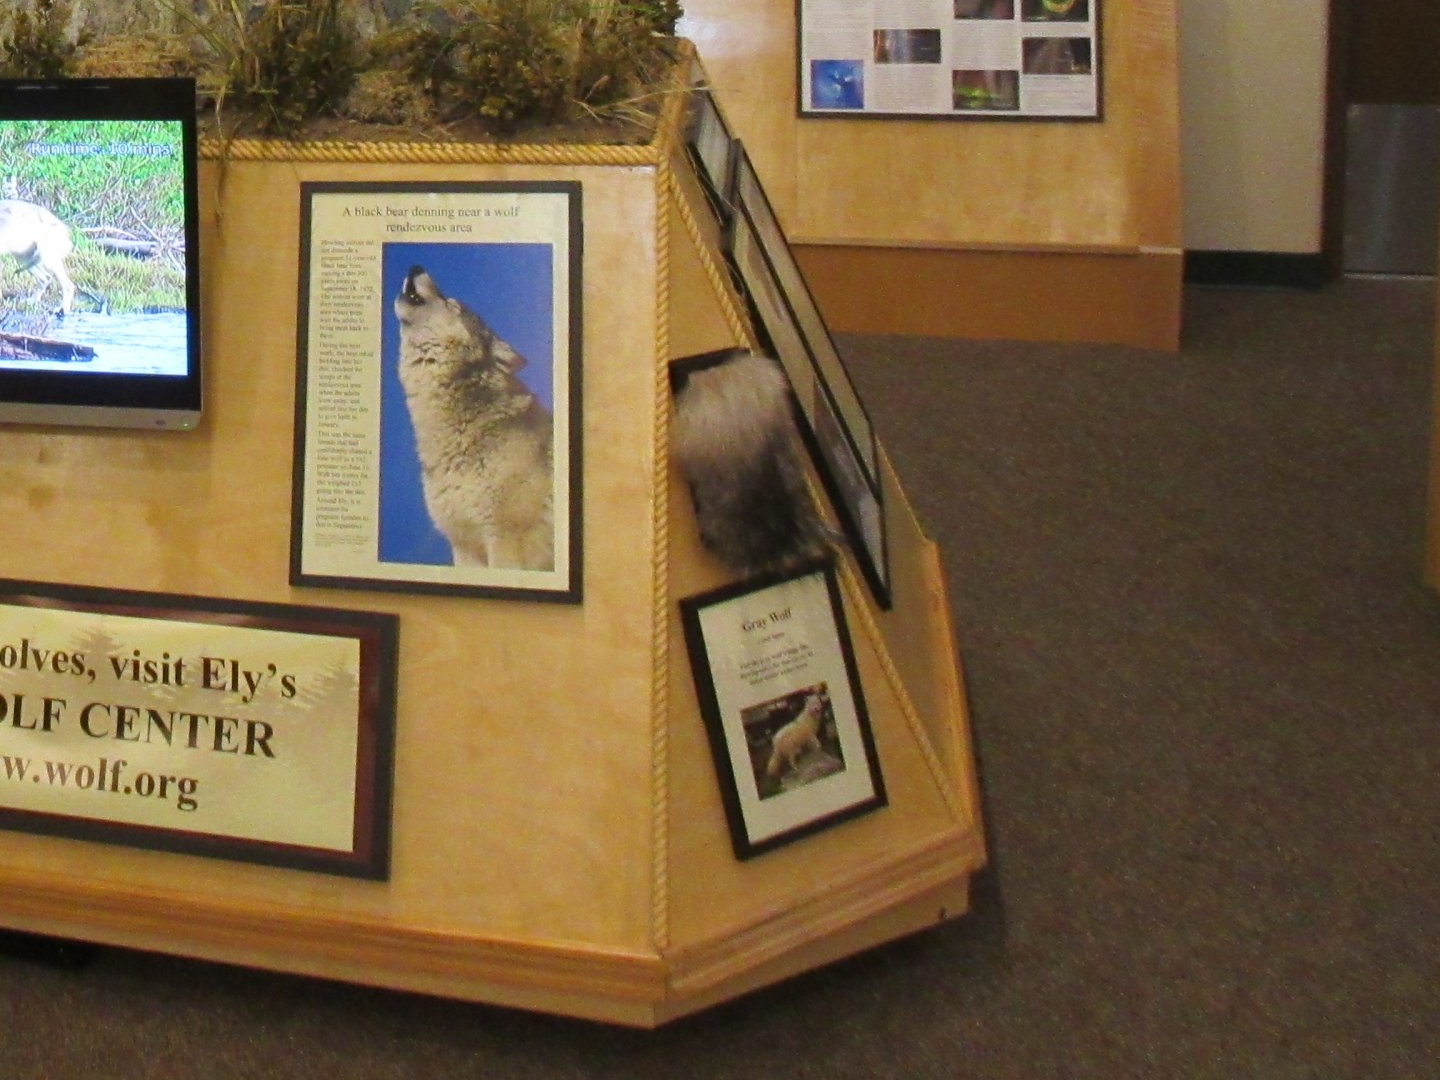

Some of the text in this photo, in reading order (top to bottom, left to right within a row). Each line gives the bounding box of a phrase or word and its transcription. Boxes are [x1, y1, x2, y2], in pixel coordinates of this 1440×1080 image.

[31, 143, 60, 154] Run
[110, 143, 128, 154] 10
[133, 143, 171, 154] mins
[342, 206, 519, 220] A black bear denning near a wolf
[386, 221, 473, 233] rendezvous area
[110, 650, 188, 687] visit
[79, 705, 276, 757] CENTER
